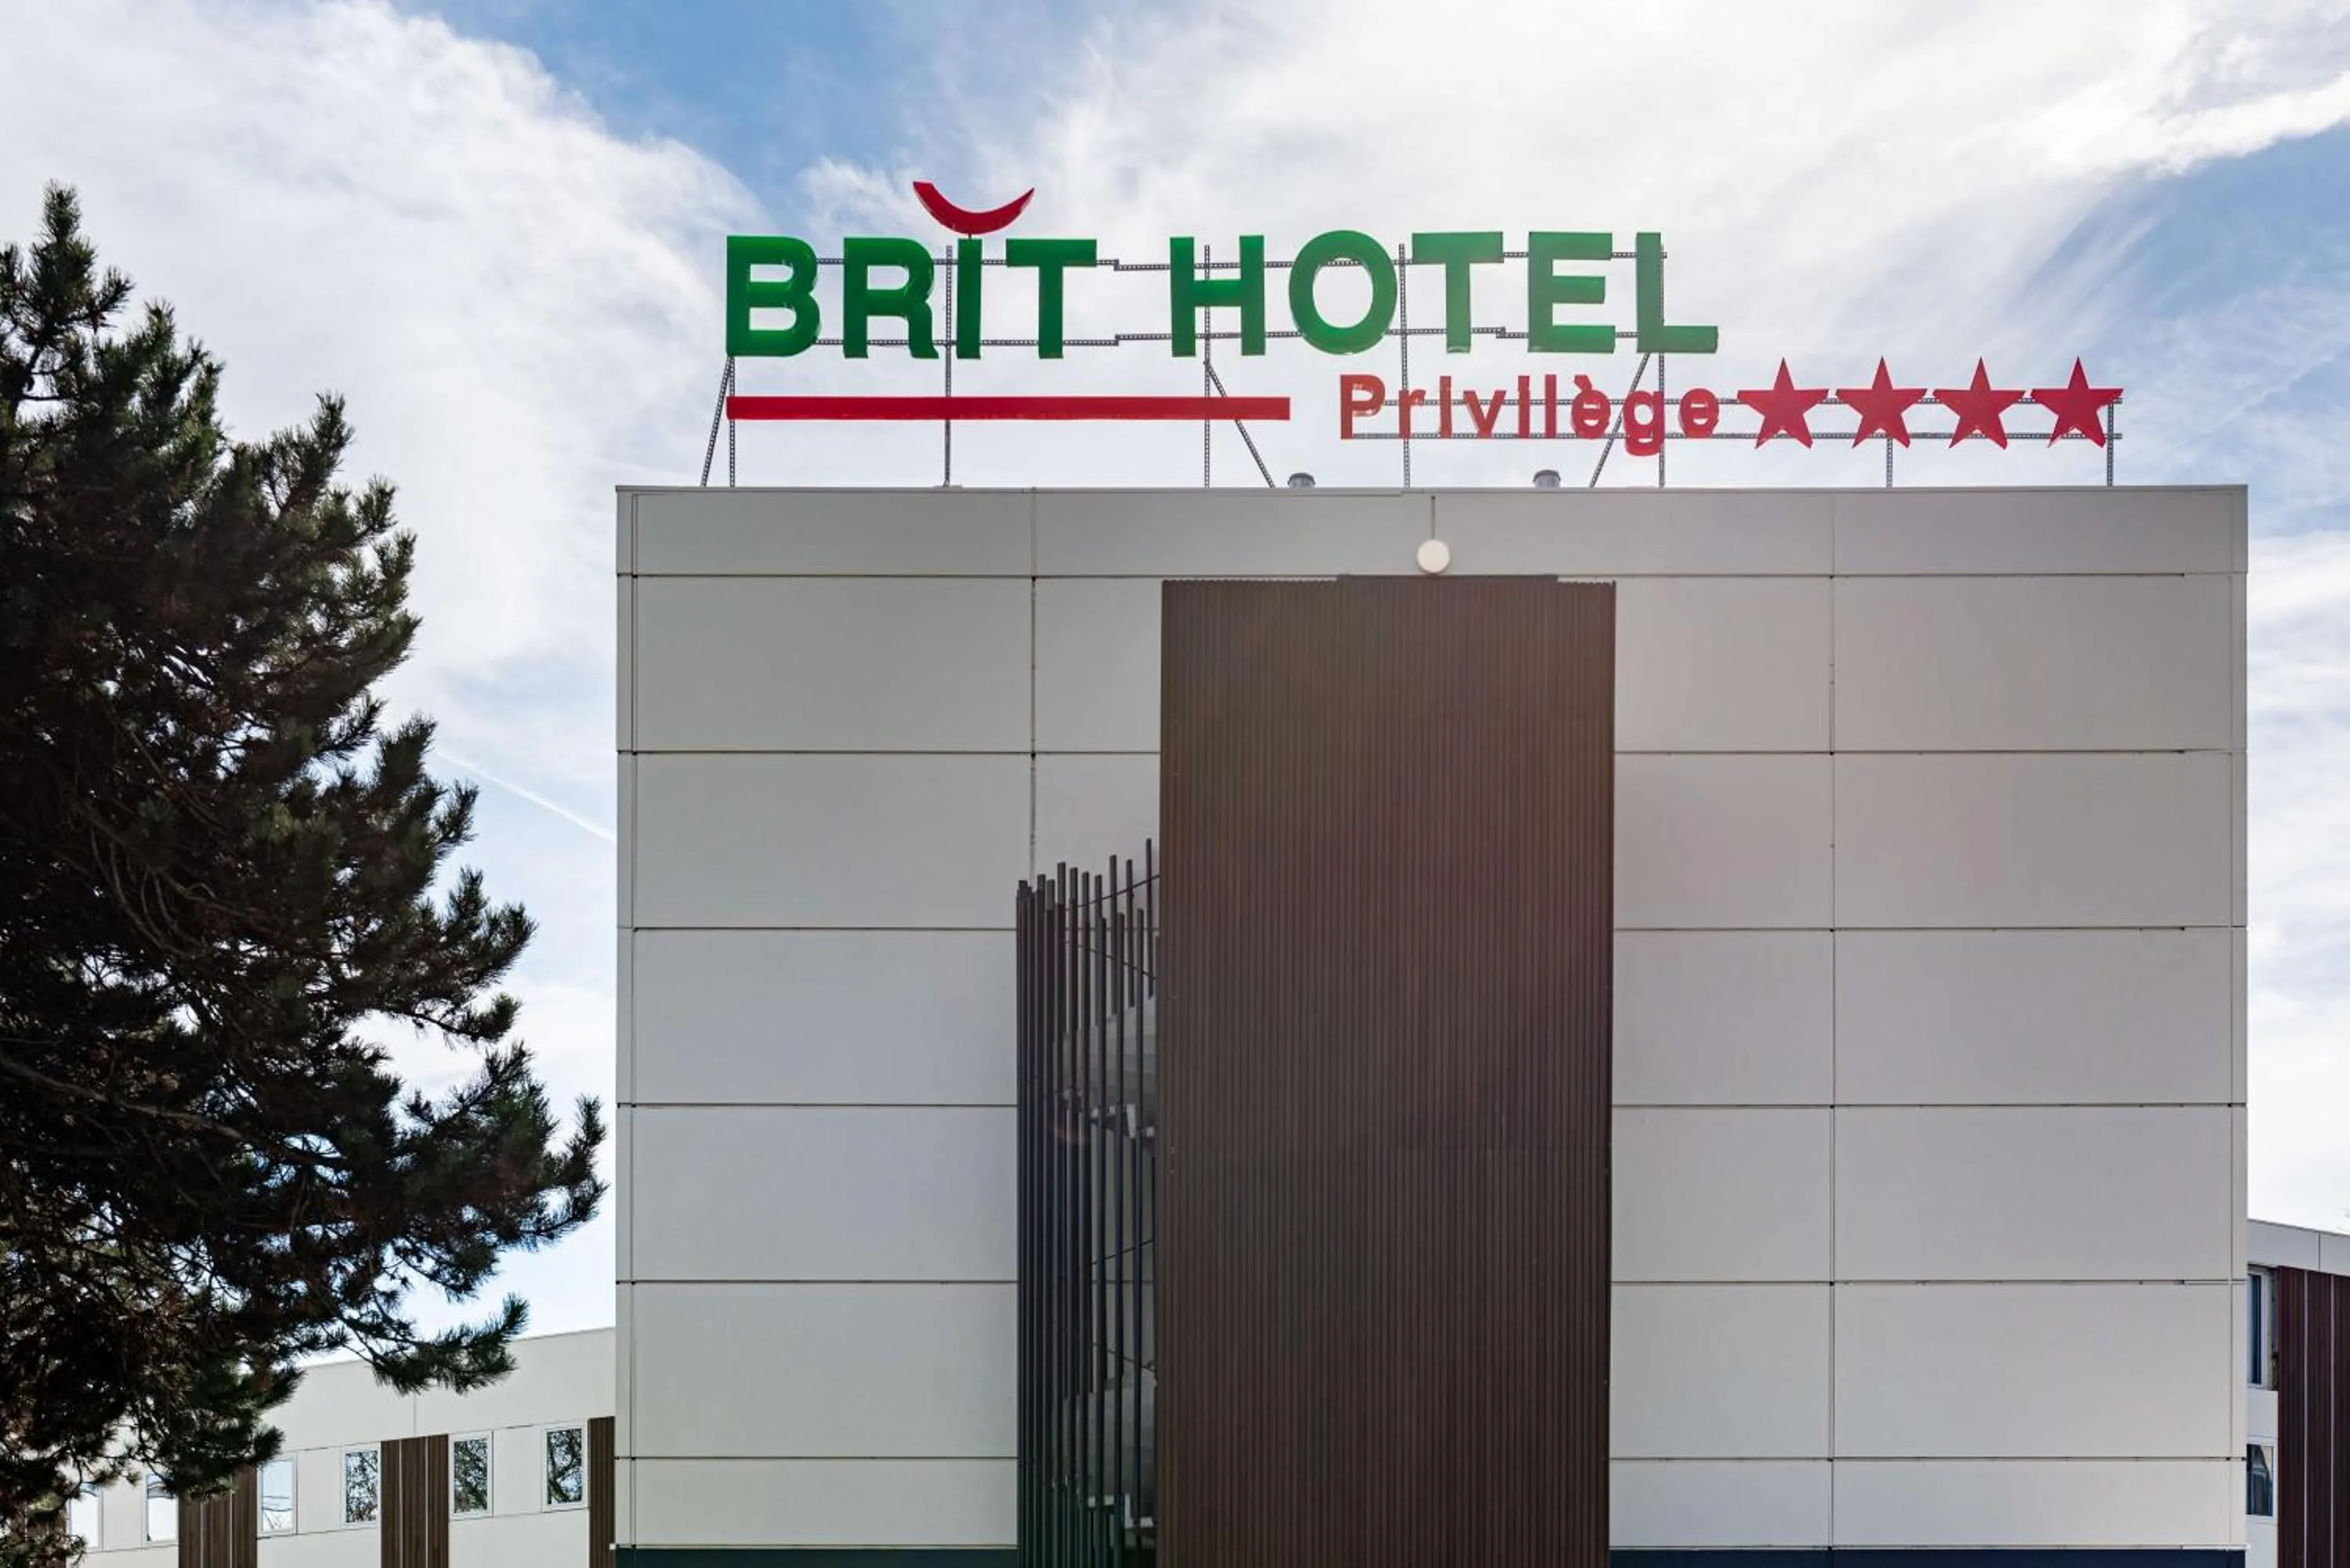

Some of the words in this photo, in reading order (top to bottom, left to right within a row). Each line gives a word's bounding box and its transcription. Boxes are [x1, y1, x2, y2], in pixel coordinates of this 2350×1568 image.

[725, 235, 1097, 359] BRIT
[1170, 229, 1718, 356] HOTEL
[1340, 374, 1719, 456] Privilège
